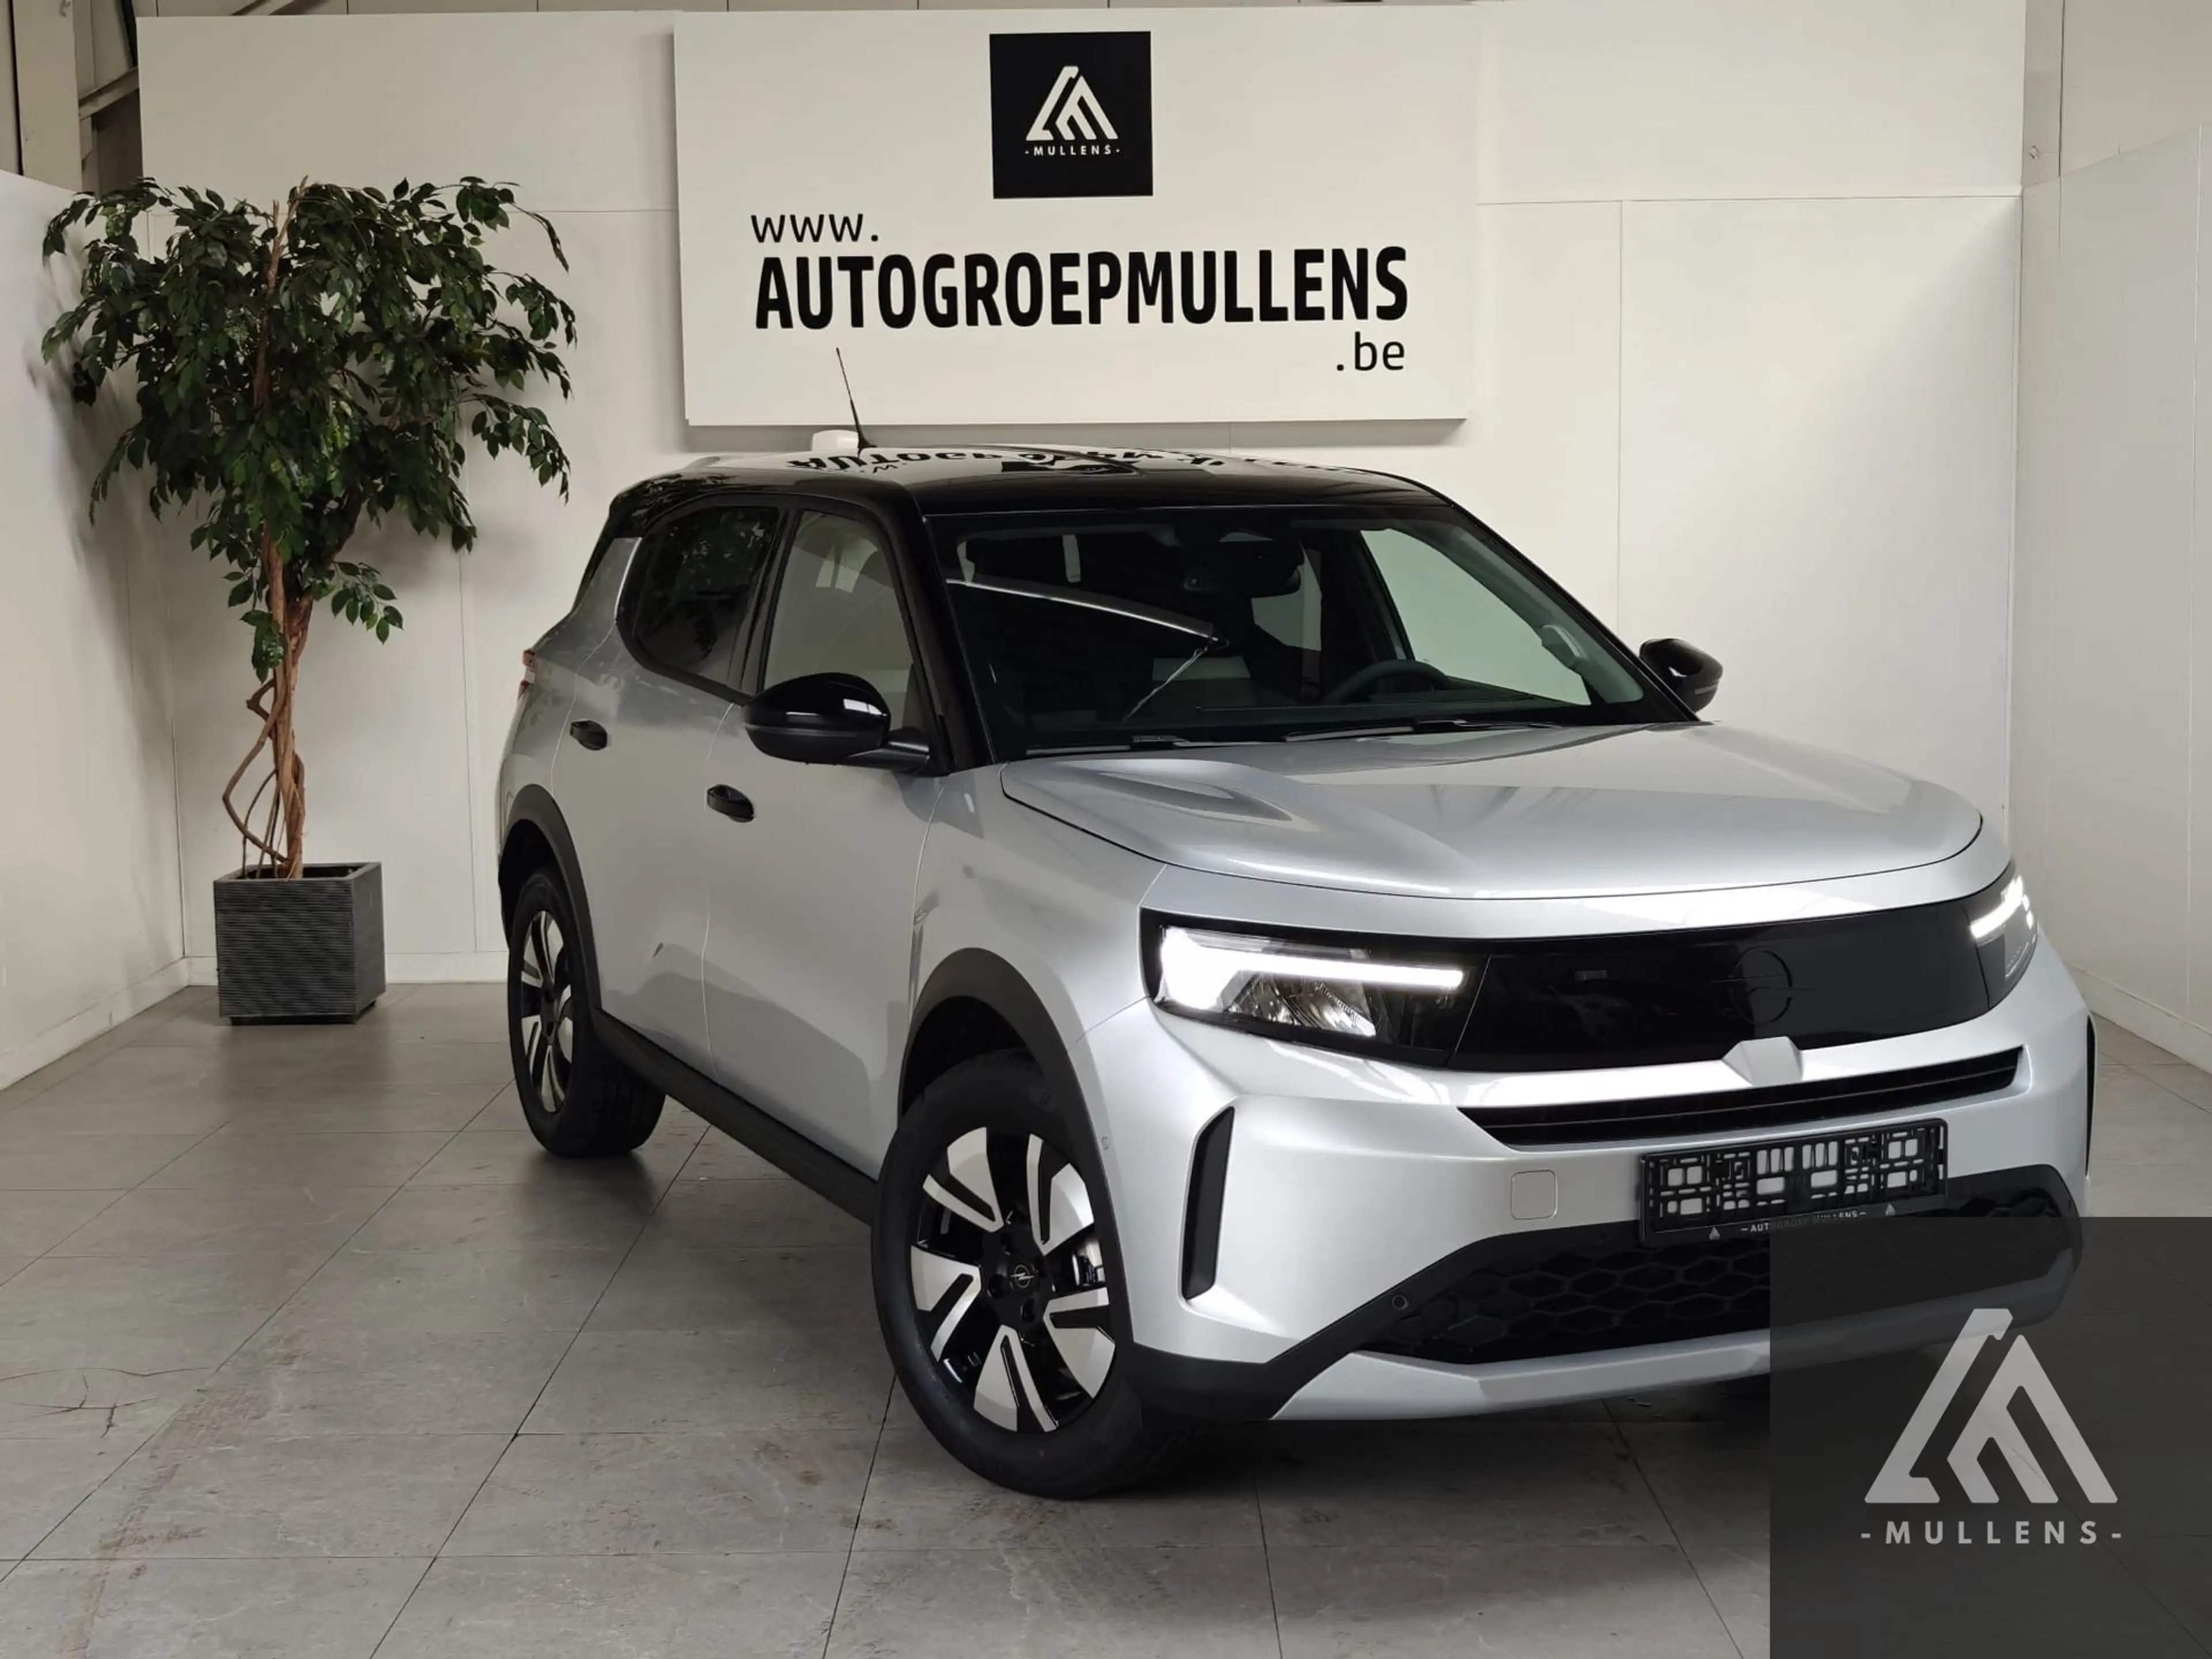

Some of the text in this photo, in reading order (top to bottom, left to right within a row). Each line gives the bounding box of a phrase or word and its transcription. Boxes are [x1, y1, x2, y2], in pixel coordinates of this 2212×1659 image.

[751, 213, 878, 243] www.
[756, 246, 1407, 329] AUTOGROEPMULLENS
[1336, 331, 1404, 371] .be
